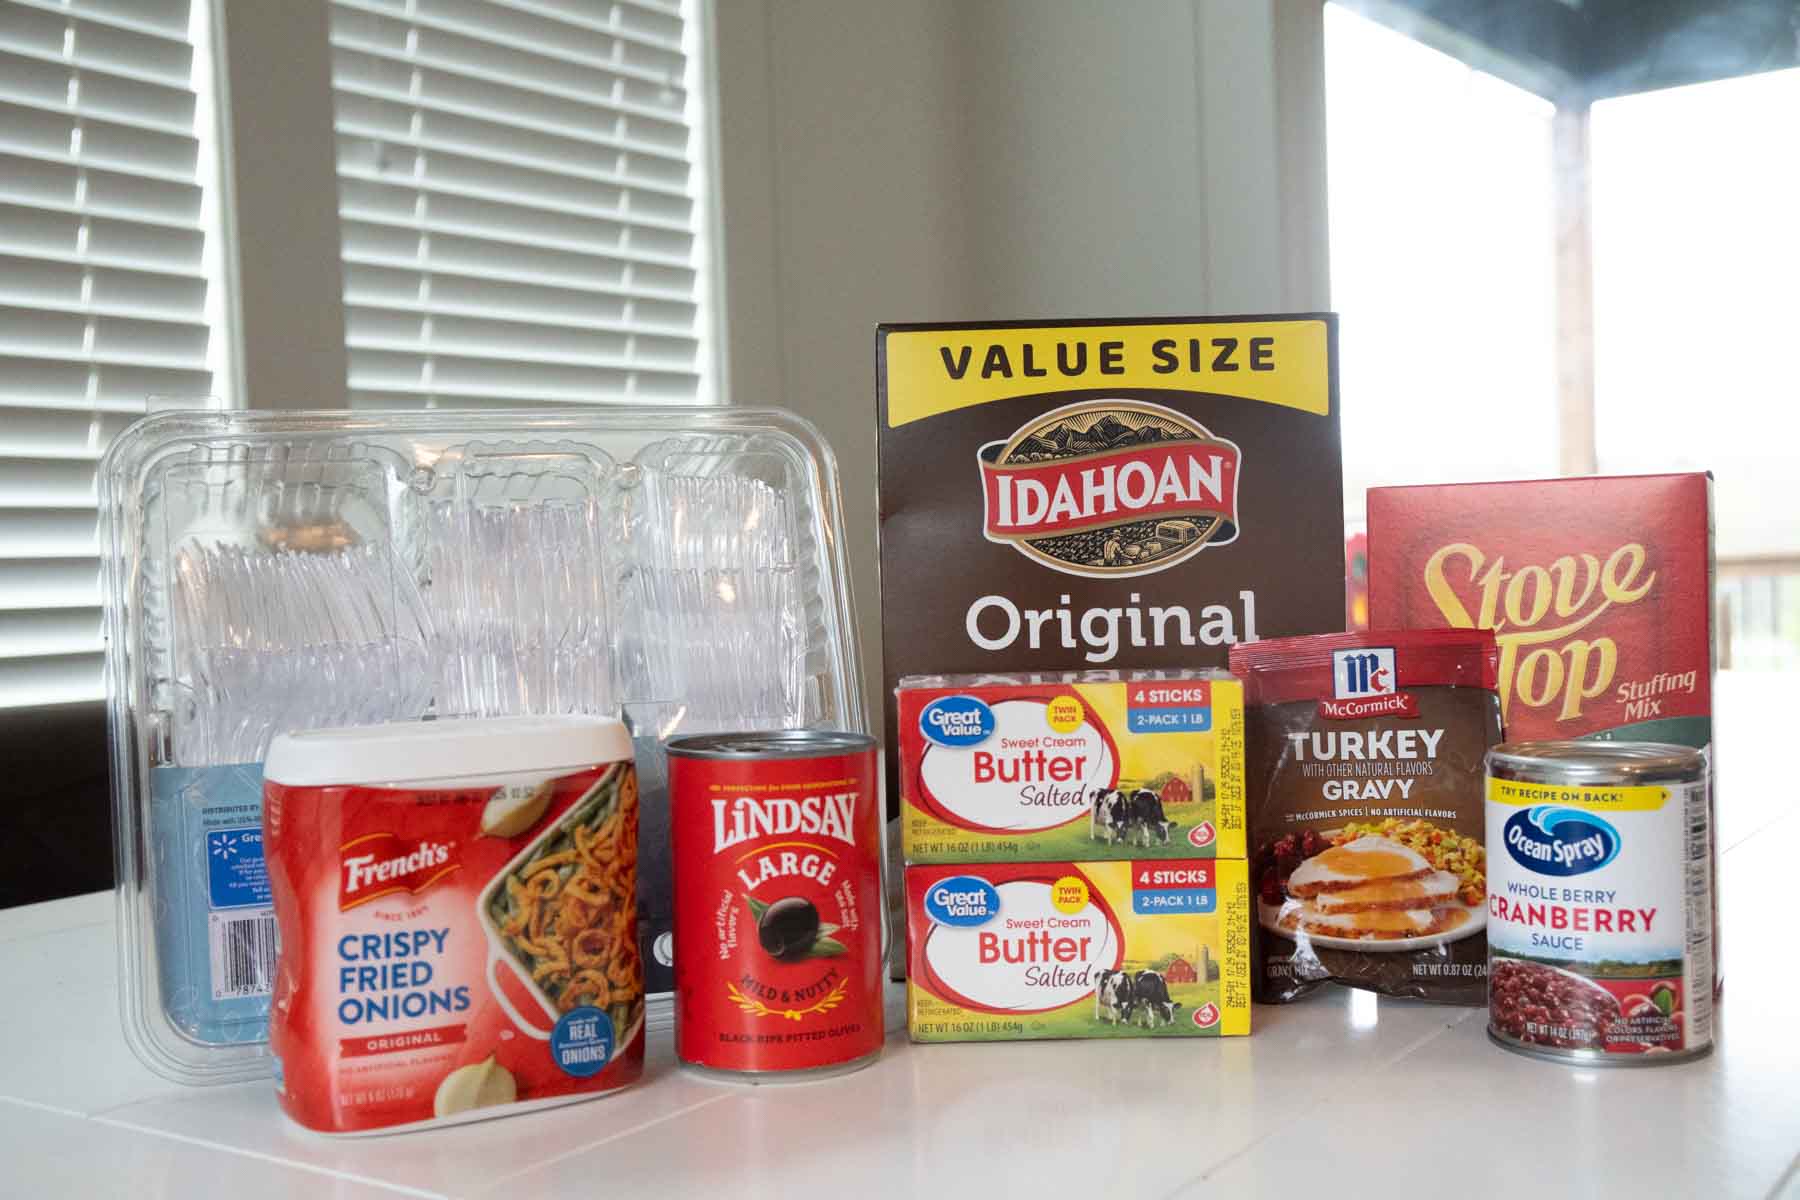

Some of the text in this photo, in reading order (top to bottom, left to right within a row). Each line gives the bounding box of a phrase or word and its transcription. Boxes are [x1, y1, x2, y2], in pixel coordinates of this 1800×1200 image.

[939, 336, 1276, 381] VALUE SIZE
[996, 454, 1224, 528] IDAHOAN
[1424, 543, 1656, 631] Stove
[966, 590, 1260, 663] Original
[1496, 636, 1618, 727] Top
[1616, 670, 1697, 704] Stuffing
[1135, 689, 1203, 703] 4 STICKS
[1323, 695, 1408, 717] McCormick
[928, 708, 981, 726] Great
[1053, 705, 1077, 715] TWIN
[1053, 714, 1077, 724] PACK
[1137, 714, 1180, 726] 2-PACK
[1191, 714, 1204, 725] LB
[1624, 698, 1661, 723] Mix
[942, 723, 983, 737] Value
[1001, 735, 1087, 749] Sweet Cream
[1288, 728, 1445, 761] TURKEY
[973, 751, 1087, 784] Butter
[1302, 761, 1433, 777] WITH OTHER NATURAL FLAVORS
[1019, 784, 1087, 806] Salted
[1322, 779, 1415, 801] GRAVY
[1501, 786, 1516, 797] TRY
[1520, 788, 1557, 801] RECIPE
[1561, 791, 1580, 802] ON
[1339, 808, 1363, 817] SPICES
[1370, 808, 1457, 820] NO ARTIFICIAL FLAVORS
[912, 843, 928, 855] NET
[930, 843, 944, 854] WT
[946, 843, 956, 854] 16
[958, 842, 969, 854] OZ
[1508, 825, 1606, 868] Ocean Spray
[343, 841, 450, 893] French's
[737, 852, 837, 891] LARGE
[1139, 870, 1208, 884] 4 STICKS
[934, 889, 987, 907] Great
[1058, 886, 1082, 895] TWIN
[1058, 895, 1082, 905] PACK
[1508, 881, 1617, 904] WHOLE BERRY
[948, 904, 988, 917] Value
[1142, 895, 1184, 907] 2-PACK
[1195, 895, 1208, 906] LB
[1006, 917, 1091, 930] Sweet Cream
[1489, 893, 1657, 934] CRANBERRY
[337, 927, 450, 961] CRISPY
[978, 931, 1092, 964] Butter
[1532, 932, 1584, 951] SAUCE
[338, 960, 433, 993] FRIED
[1024, 965, 1092, 988] Salted
[1412, 964, 1427, 976] NET
[1429, 965, 1442, 976] WT
[1443, 965, 1461, 976] 0.87
[1463, 965, 1474, 976] OZ
[741, 968, 840, 1004] MILD & NUTTY
[338, 985, 471, 1025] ONIONS
[569, 1023, 598, 1041] REAL
[918, 1023, 934, 1033] NET
[936, 1023, 950, 1033] WT
[951, 1023, 961, 1033] 16
[962, 1022, 975, 1033] OZ
[1002, 1021, 1024, 1033] 454g
[367, 1031, 442, 1051] ORIGINAL
[562, 1044, 606, 1065] ONIONS
